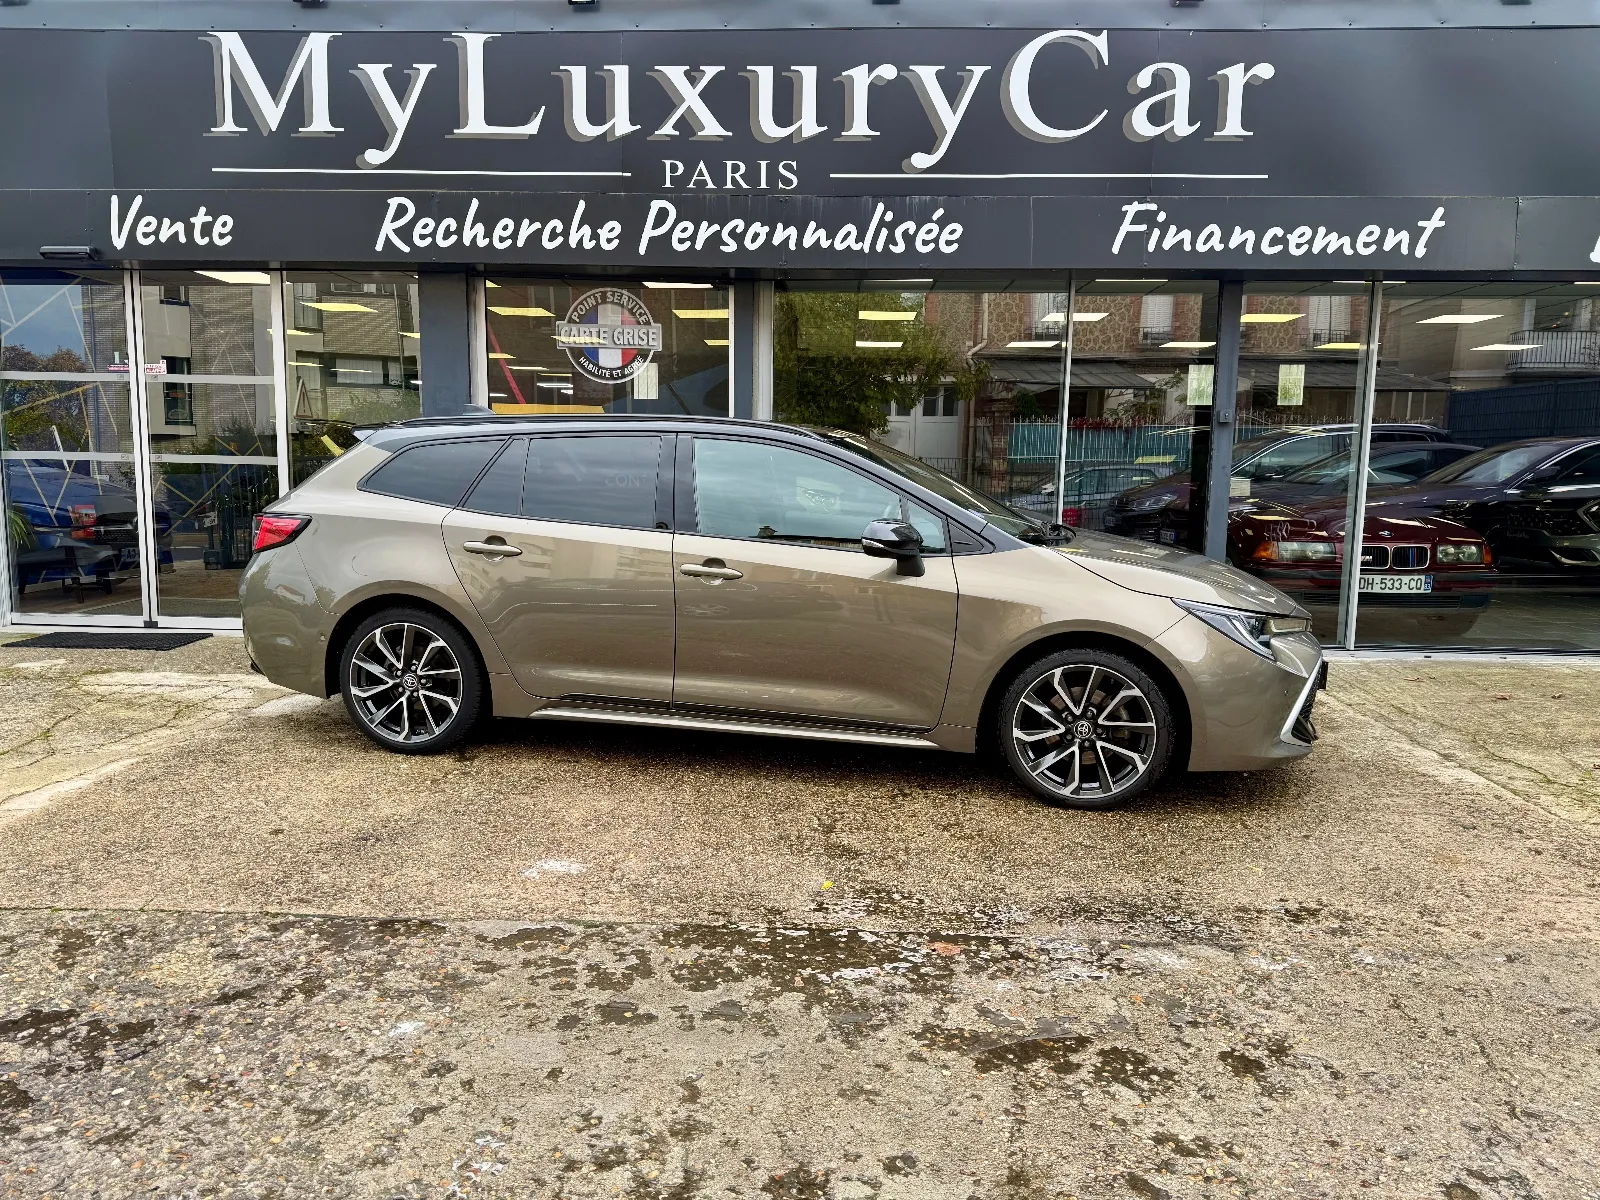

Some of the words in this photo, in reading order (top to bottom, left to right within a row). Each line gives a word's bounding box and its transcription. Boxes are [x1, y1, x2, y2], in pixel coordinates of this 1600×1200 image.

[201, 30, 1275, 171] MyLuxuryCar
[662, 160, 798, 190] PARIS
[111, 195, 233, 250] Vente
[375, 197, 622, 252] Recherche
[639, 200, 963, 256] Personnalisée
[1112, 201, 1446, 258] Financement
[571, 293, 602, 323] POINT
[606, 291, 649, 325] SERVICE
[560, 326, 608, 345] CARTE
[614, 328, 658, 346] GRISE
[578, 356, 611, 378] HABILITÉ
[613, 369, 622, 377] ET
